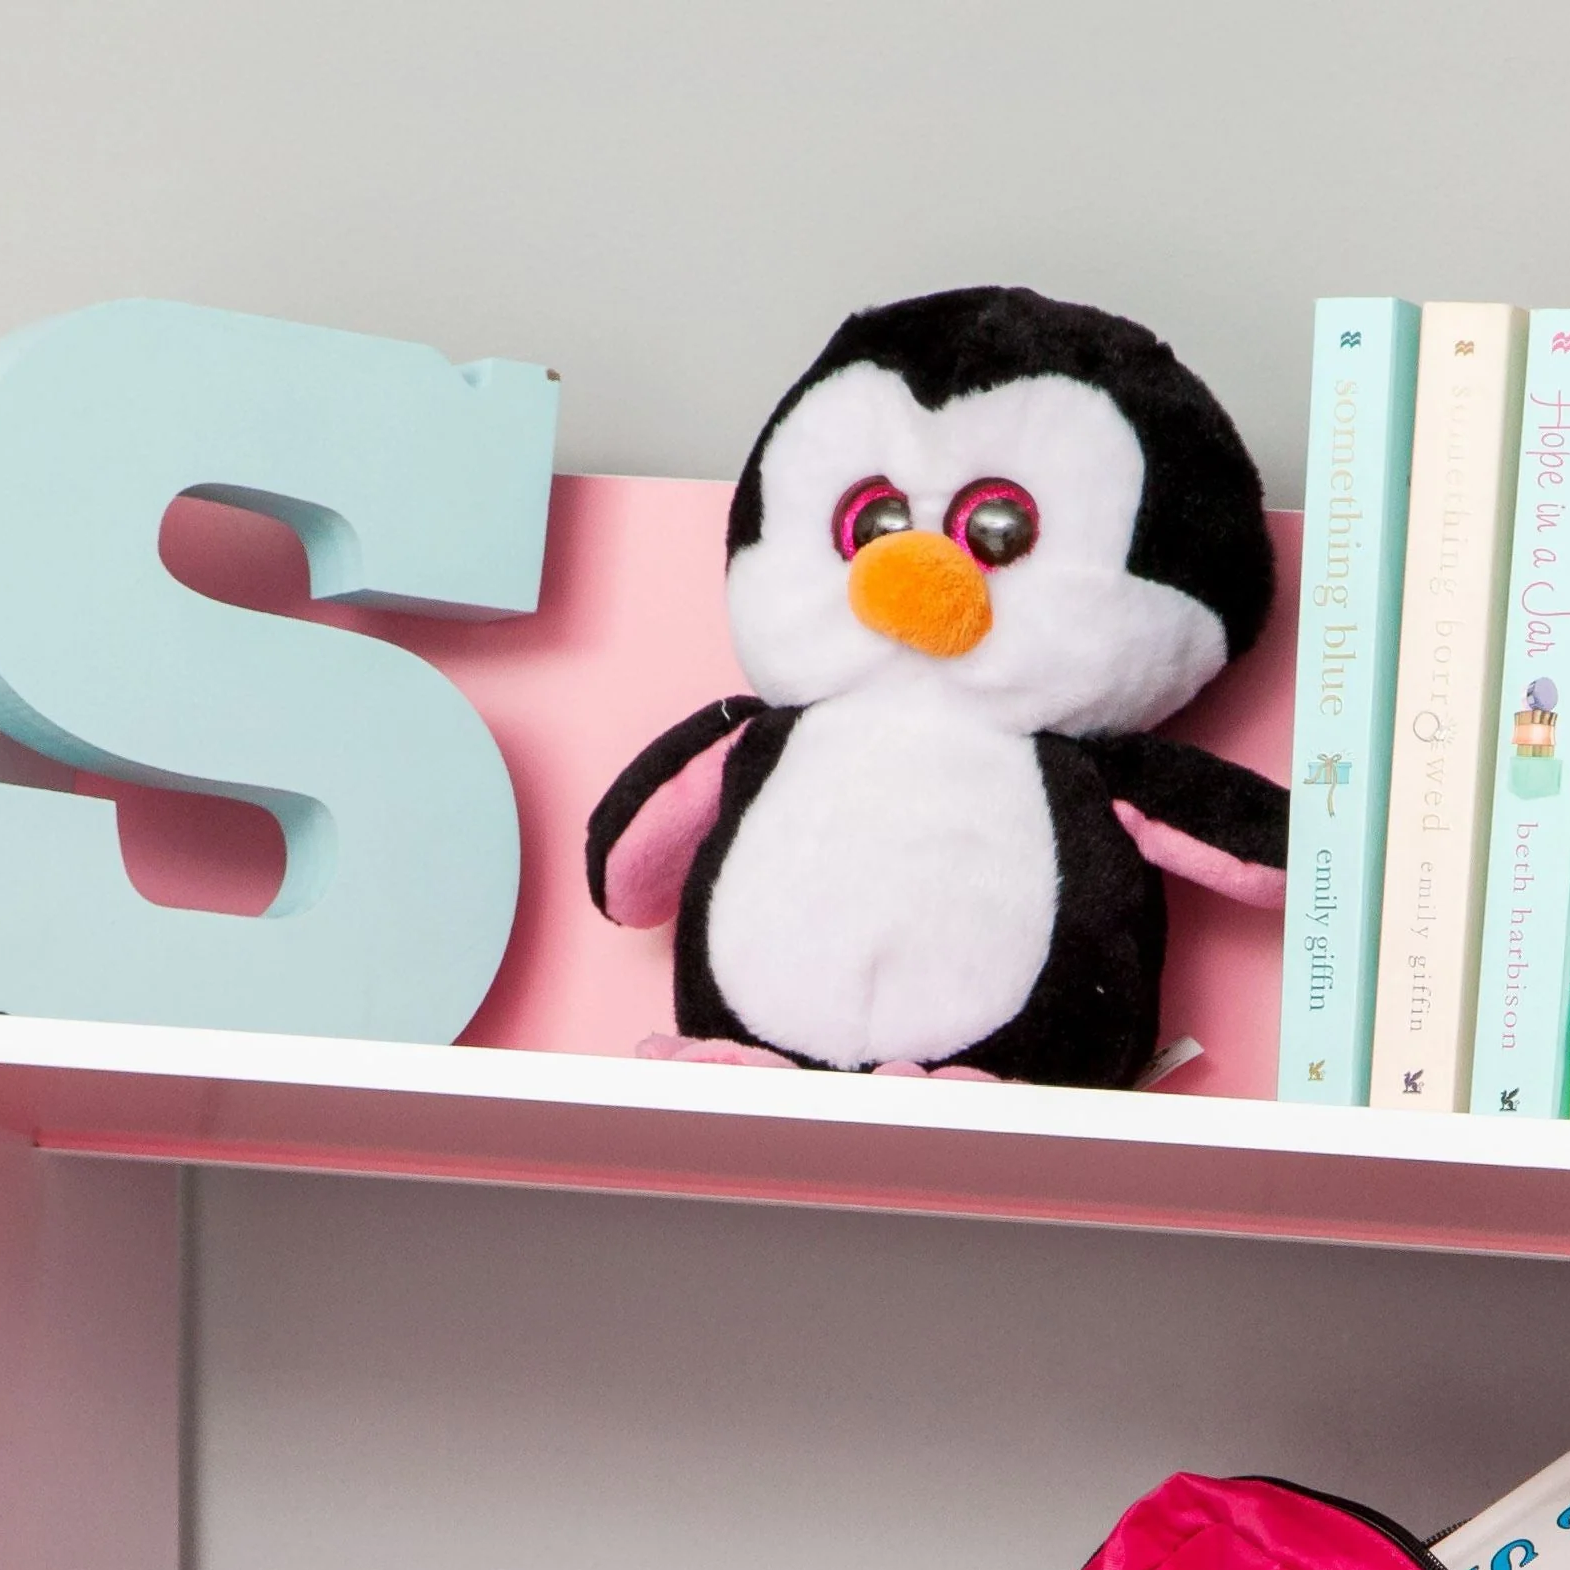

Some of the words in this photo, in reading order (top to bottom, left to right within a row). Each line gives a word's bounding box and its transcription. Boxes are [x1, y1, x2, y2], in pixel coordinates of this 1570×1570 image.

[1312, 379, 1364, 609] something
[1429, 385, 1471, 598] something
[1534, 503, 1566, 532] in
[1532, 547, 1557, 569] a
[1319, 624, 1359, 716] blue
[1305, 848, 1338, 927] emily
[1513, 822, 1538, 892] beth
[1409, 861, 1437, 938] emily
[1303, 935, 1336, 1011] giffin
[1408, 954, 1433, 1032] giffin
[1501, 909, 1533, 1051] harbison
